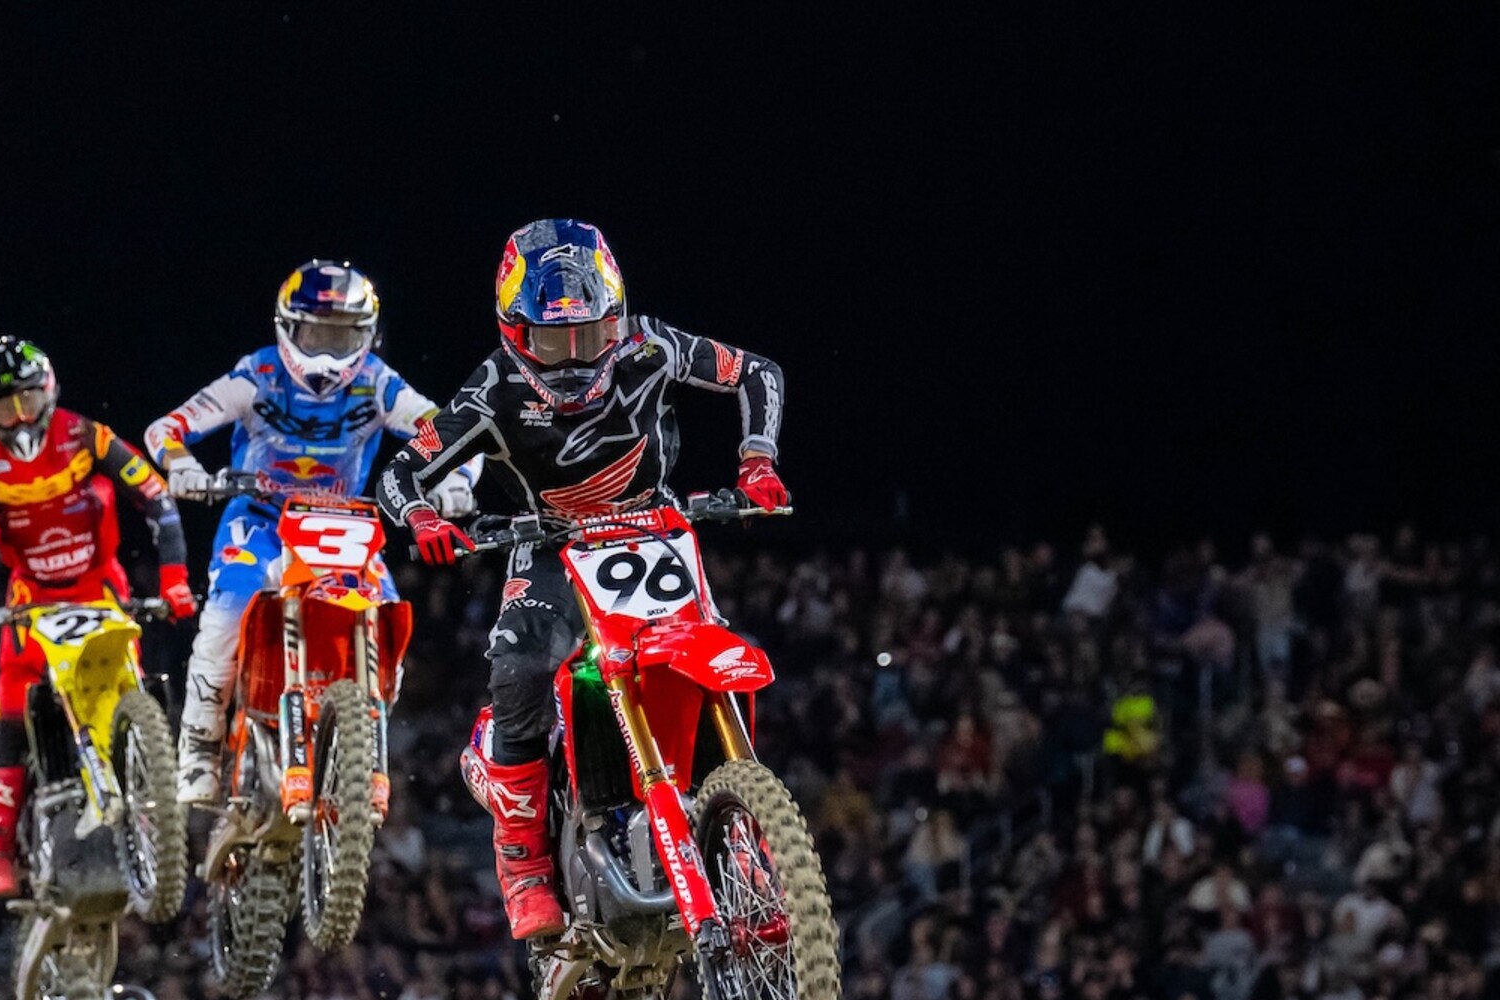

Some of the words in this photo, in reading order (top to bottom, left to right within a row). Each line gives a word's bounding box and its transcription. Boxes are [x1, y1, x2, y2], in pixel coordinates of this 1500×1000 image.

[542, 307, 566, 320] Red
[569, 305, 591, 318] Bull
[26, 544, 97, 573] SUZUKI
[292, 517, 376, 568] 3
[596, 551, 694, 604] 96
[653, 815, 694, 905] DUNLOP
